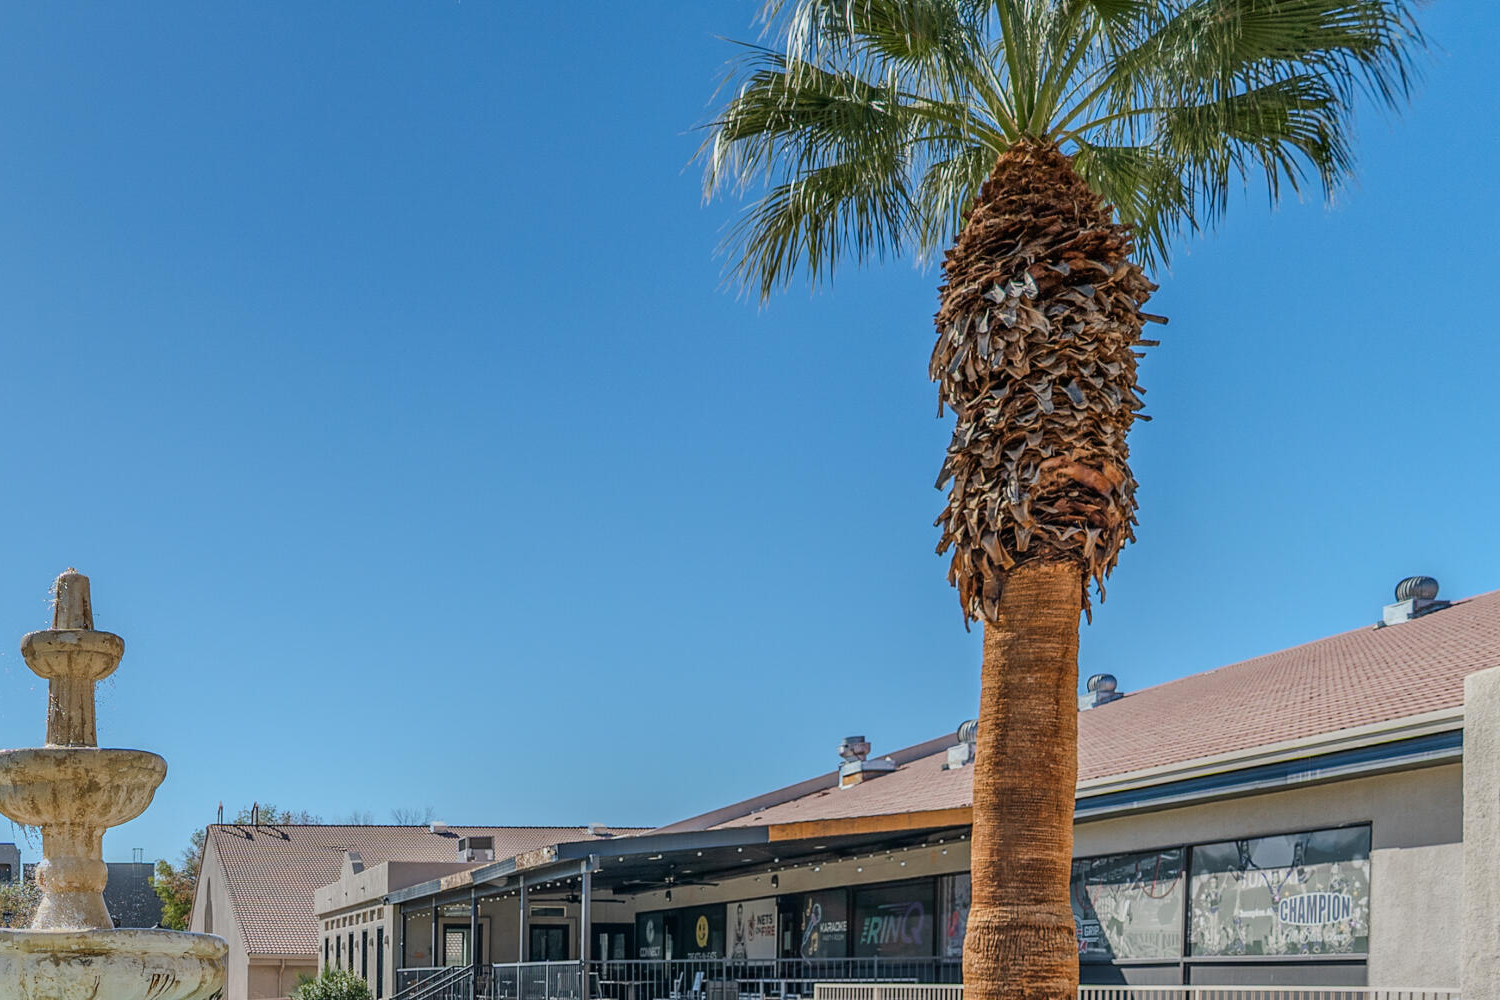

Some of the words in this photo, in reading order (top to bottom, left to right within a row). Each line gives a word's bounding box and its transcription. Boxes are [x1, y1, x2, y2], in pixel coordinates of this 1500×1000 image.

[1280, 894, 1350, 923] CHAMPION
[757, 914, 773, 925] NETS
[762, 925, 775, 936] FIRE
[820, 921, 847, 932] KARAOKE
